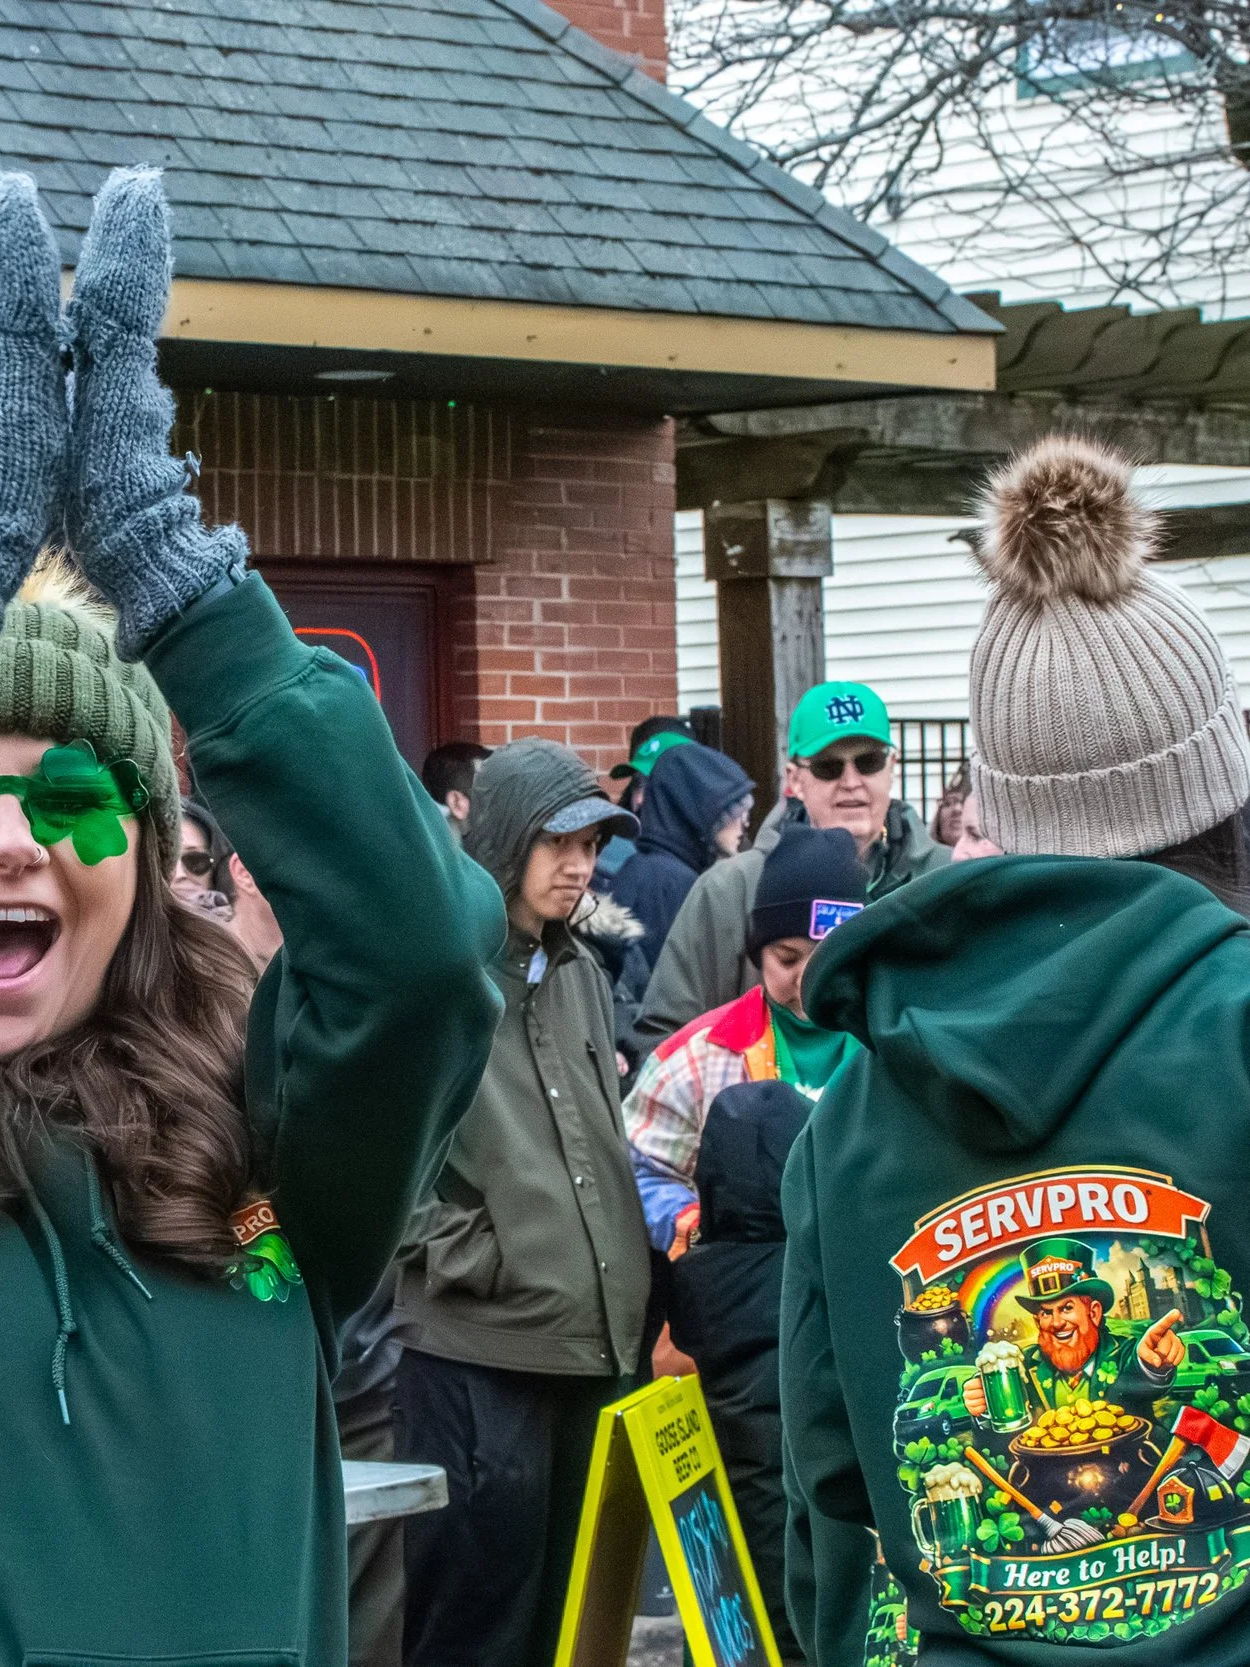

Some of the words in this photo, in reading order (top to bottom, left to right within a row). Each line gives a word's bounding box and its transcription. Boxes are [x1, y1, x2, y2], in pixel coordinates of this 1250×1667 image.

[934, 1183, 1149, 1262] SERVPRO
[1031, 1263, 1075, 1277] SERVPRO
[655, 1421, 681, 1456] GOOSE
[673, 1451, 692, 1483] BEER
[1004, 1563, 1070, 1588] Here
[1079, 1559, 1105, 1582] to
[1113, 1539, 1186, 1572] Help!
[985, 1573, 1220, 1632] 224-372-7772
